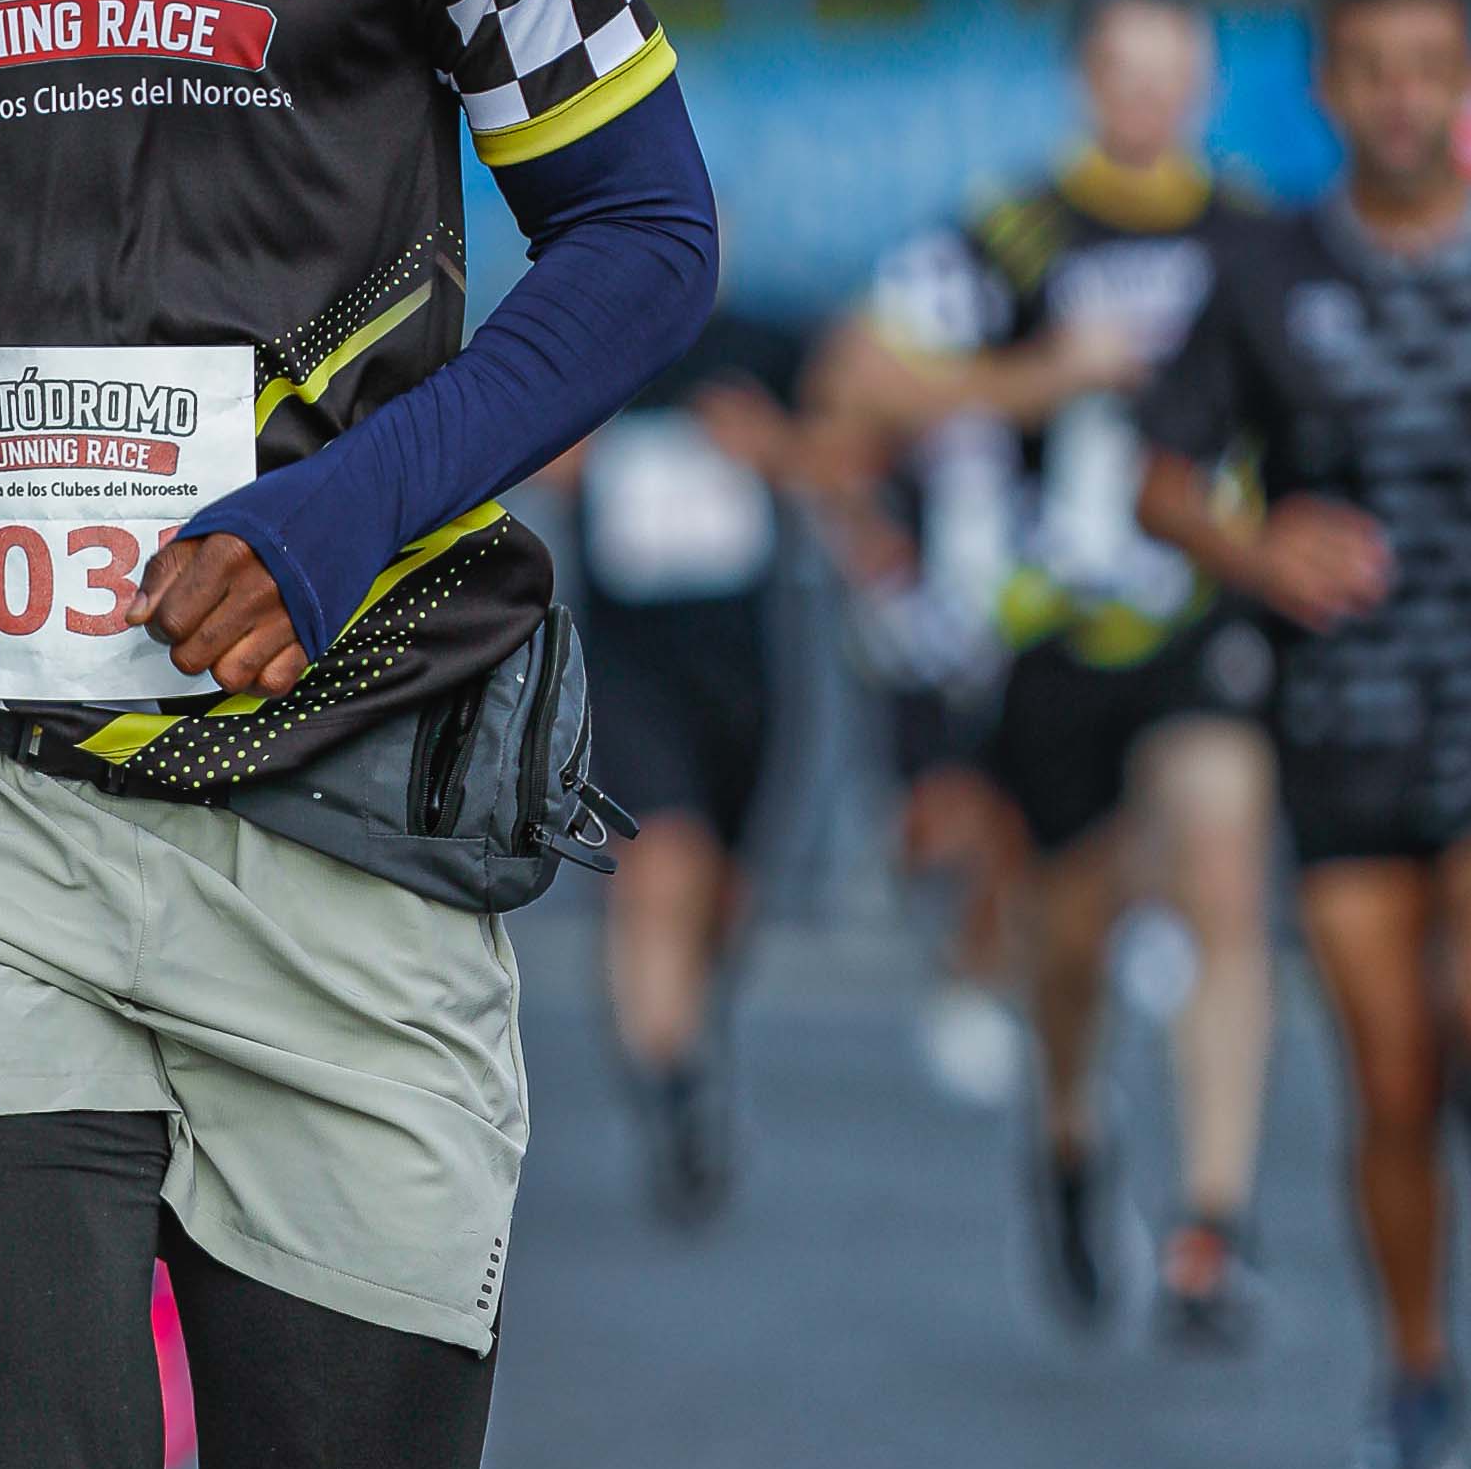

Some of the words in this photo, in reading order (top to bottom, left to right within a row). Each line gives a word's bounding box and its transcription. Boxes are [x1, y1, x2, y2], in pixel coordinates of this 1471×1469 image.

[33, 83, 124, 115] Clubes
[131, 77, 173, 106] del
[182, 77, 296, 111] Noroese
[86, 439, 152, 470] RACE
[7, 481, 25, 498] de
[27, 481, 48, 498] los
[51, 481, 101, 498] Clubes
[104, 482, 128, 498] del
[131, 482, 199, 498] Noroeste
